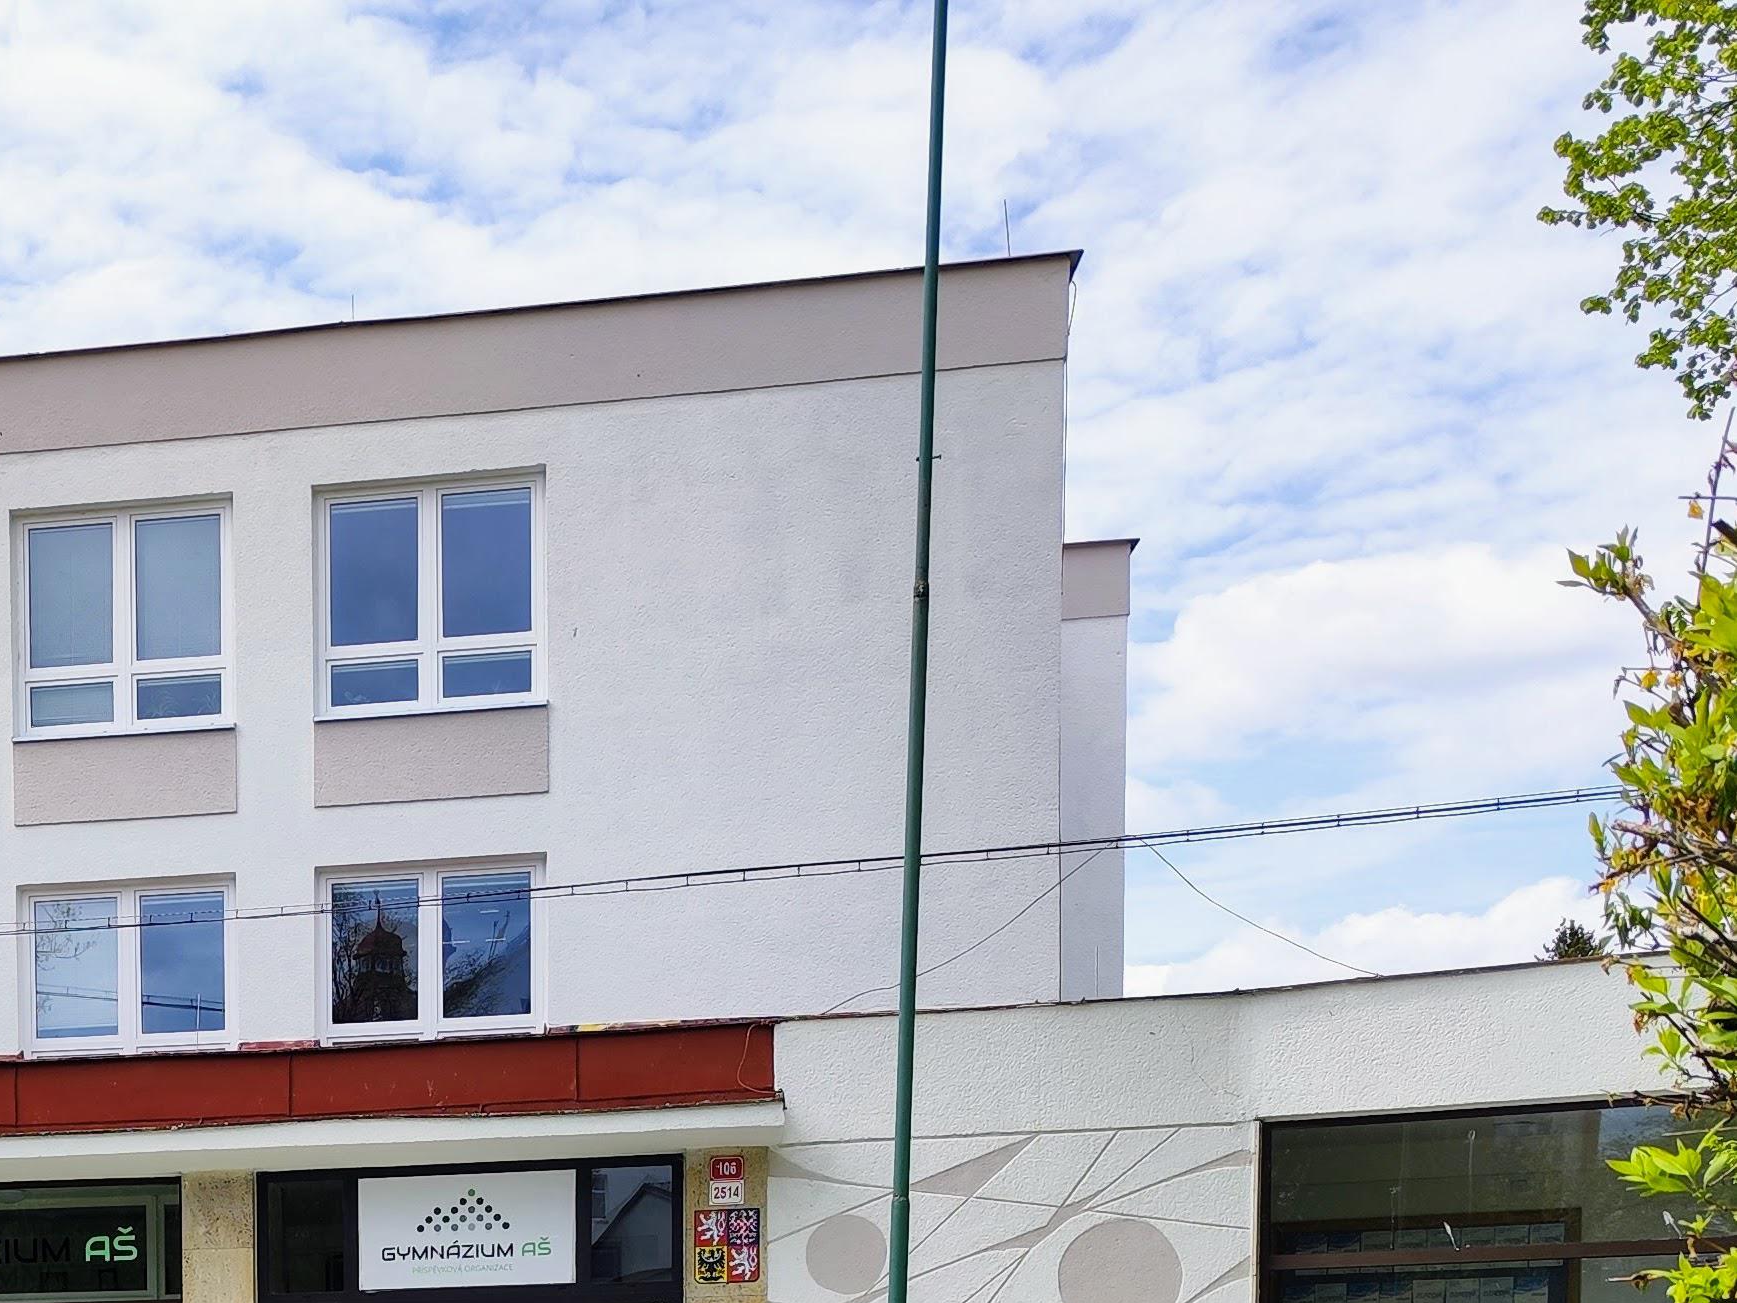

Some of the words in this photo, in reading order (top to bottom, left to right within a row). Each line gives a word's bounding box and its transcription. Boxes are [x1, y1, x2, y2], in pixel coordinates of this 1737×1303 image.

[715, 1161, 737, 1176] 106
[714, 1185, 740, 1199] 2514
[85, 1226, 138, 1262] AŠ
[381, 1239, 514, 1262] GYMNÁZIUM
[521, 1236, 552, 1257] AŠ
